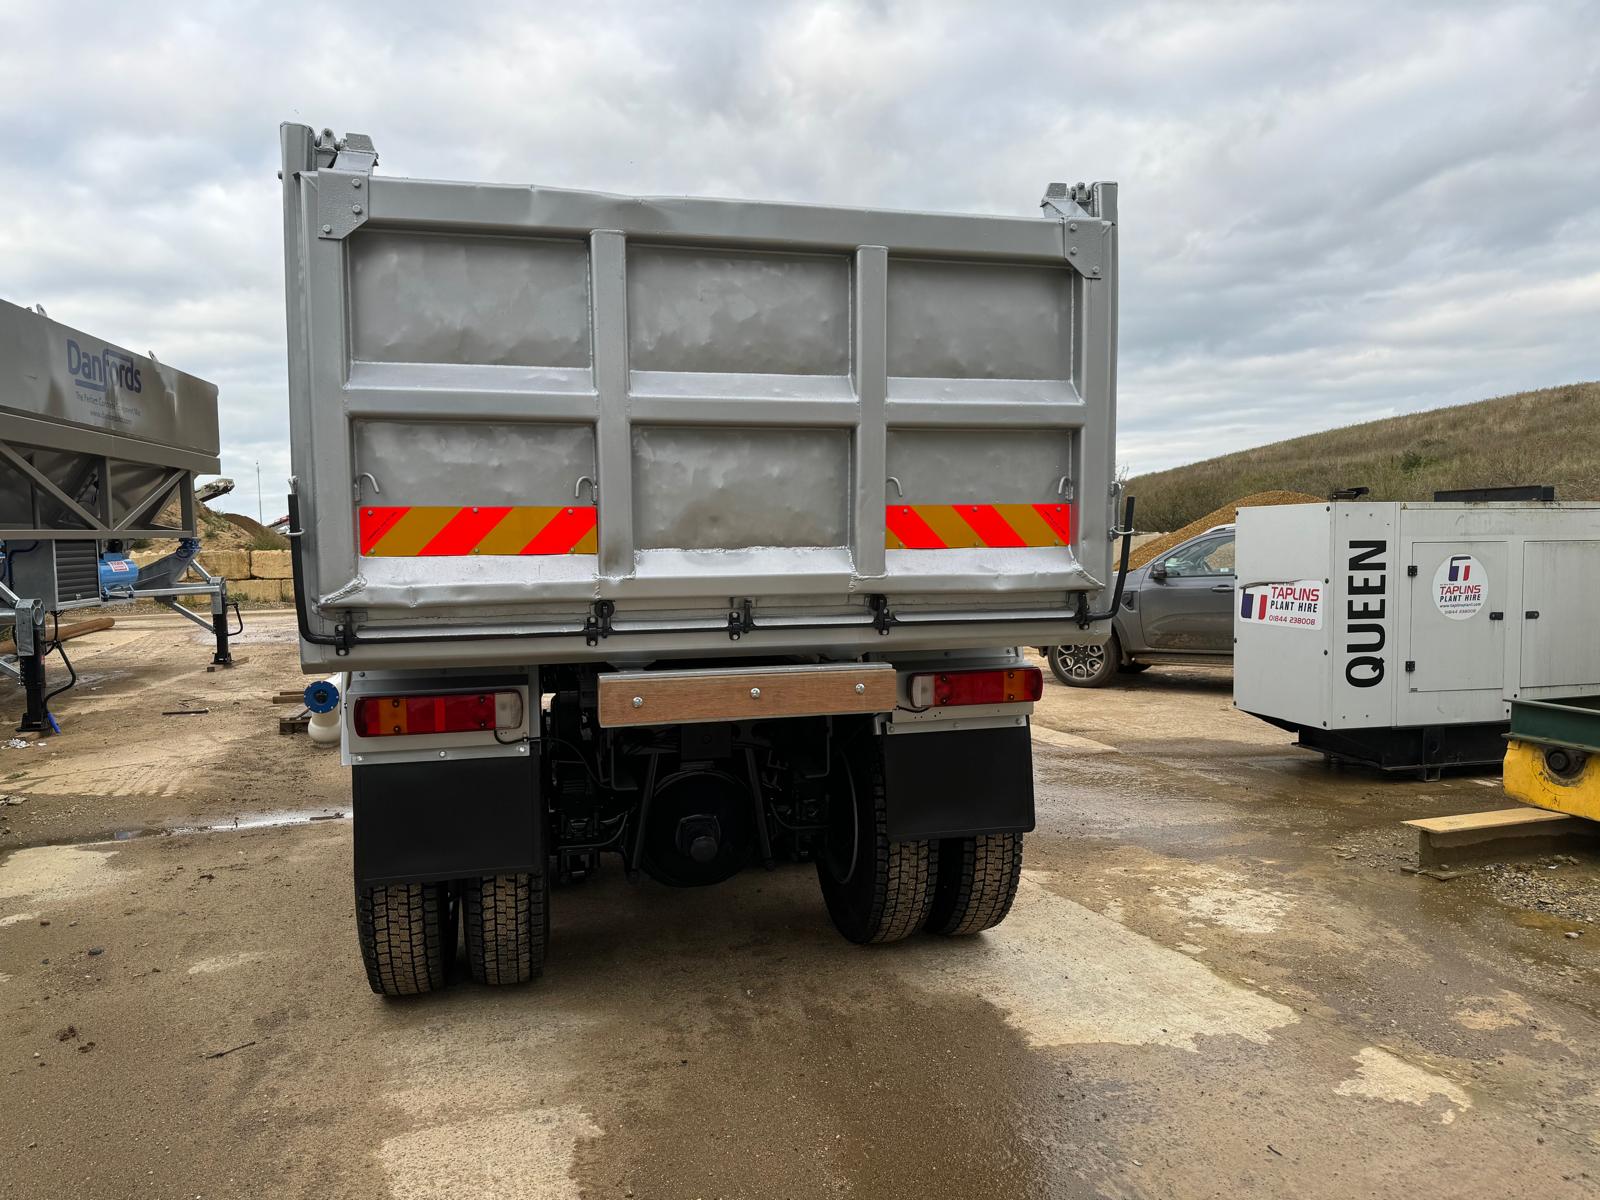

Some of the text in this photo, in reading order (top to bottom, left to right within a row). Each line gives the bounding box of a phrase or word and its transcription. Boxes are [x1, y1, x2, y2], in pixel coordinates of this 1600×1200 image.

[66, 339, 142, 393] Danfords
[1272, 587, 1320, 602] TAPLINS
[1440, 585, 1481, 595] TAPLINS
[1270, 600, 1318, 613] PLANT HIRE
[1289, 617, 1315, 625] 238008
[1345, 540, 1386, 688] QUEEN
